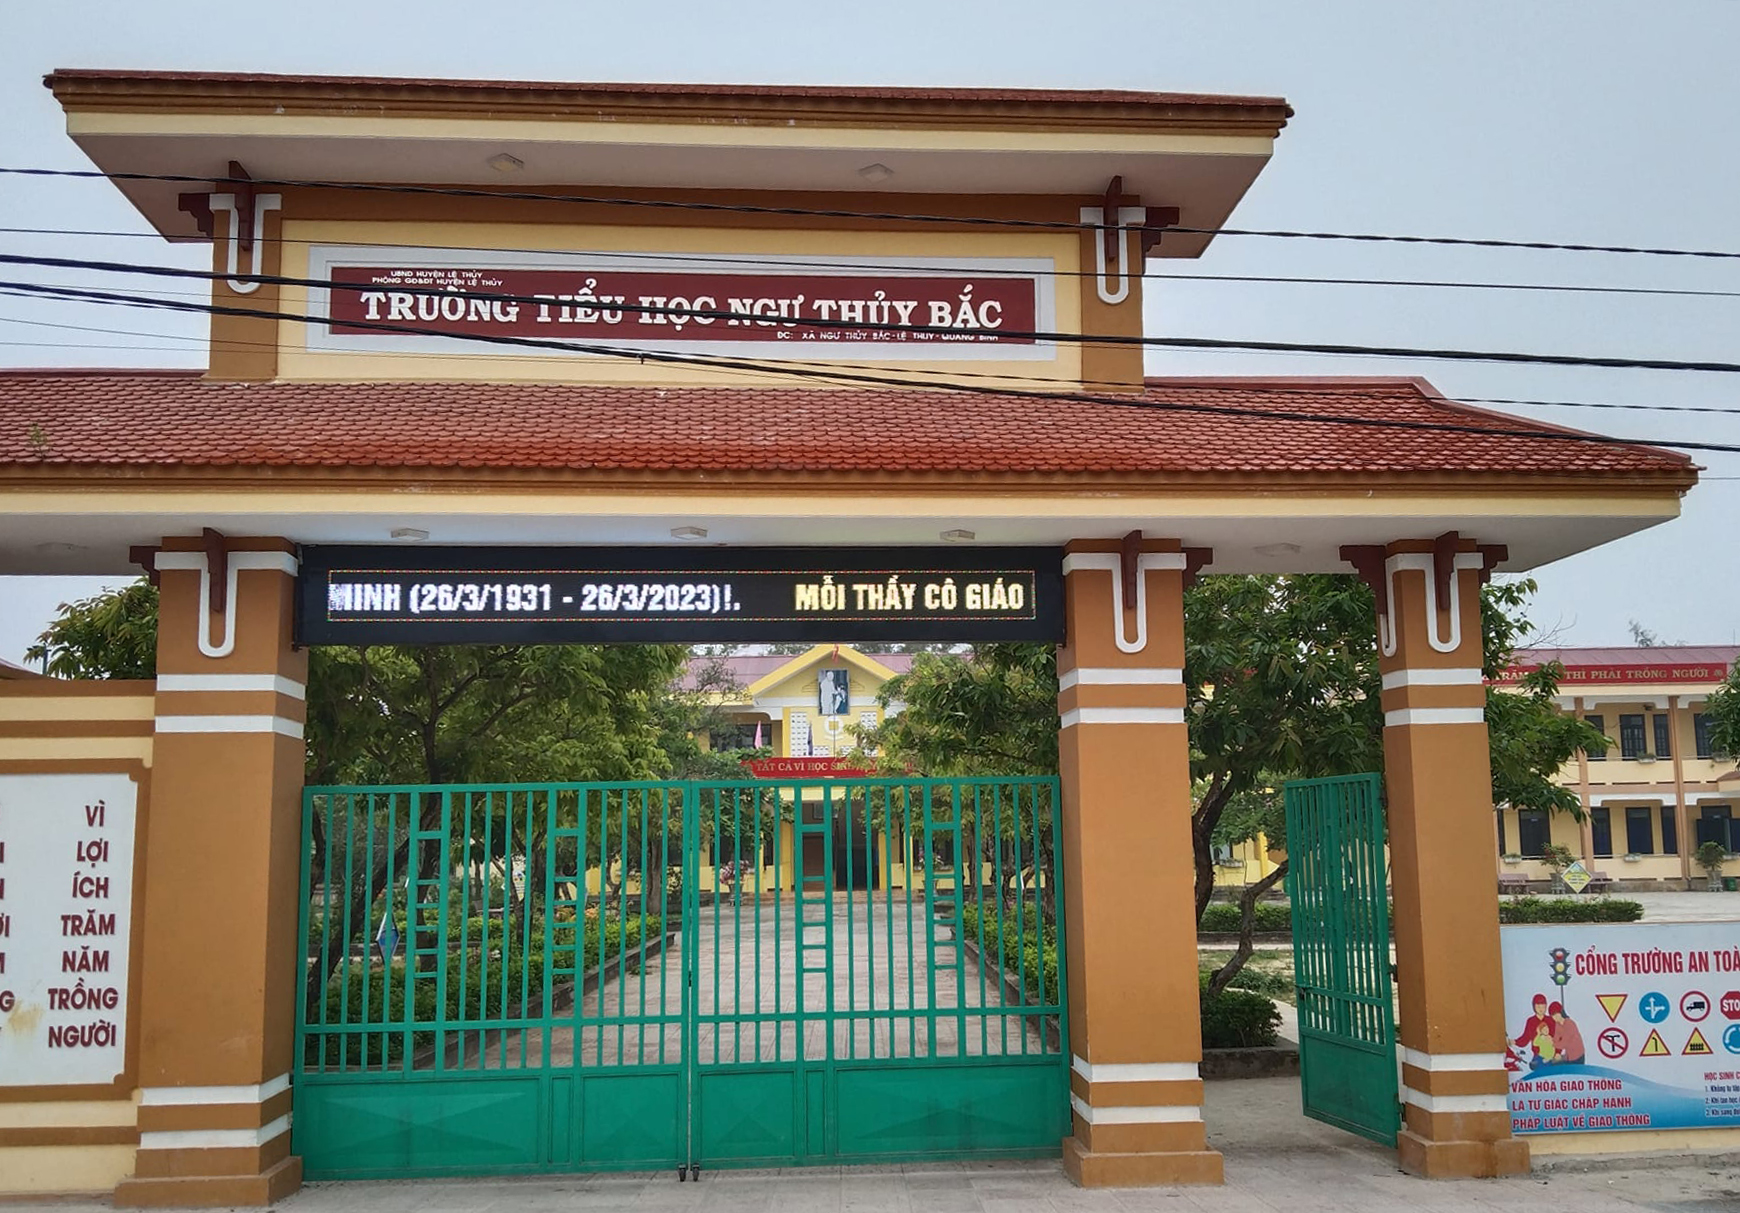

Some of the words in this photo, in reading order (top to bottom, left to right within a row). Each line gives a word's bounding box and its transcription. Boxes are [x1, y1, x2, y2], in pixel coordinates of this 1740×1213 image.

[390, 270, 414, 278] UBND
[534, 278, 625, 324] TIỂU
[638, 295, 717, 331] HỌC
[727, 294, 805, 327] NGƯ
[812, 290, 919, 327] THỦY
[928, 284, 1003, 329] BẮC
[409, 583, 552, 614] (26/3/1931
[562, 596, 573, 604] -
[795, 575, 846, 611] MỖI
[924, 577, 958, 611] CÔ
[965, 577, 1025, 611] GIÁO
[1672, 665, 1709, 678] NGƯỜI
[807, 762, 828, 774] HỌC
[85, 800, 106, 827] VÌ
[76, 838, 109, 868] LỢI
[72, 871, 110, 899] ÍCH
[61, 908, 116, 937] TRĂM
[61, 945, 110, 973] NĂM
[1575, 944, 1618, 976] CỔNG
[1622, 947, 1684, 975] TRƯỜNG
[1688, 951, 1711, 973] AN
[48, 977, 119, 1011] TRỒNG
[48, 1019, 117, 1049] NGƯỜI
[1560, 1080, 1585, 1092] GIAO
[1588, 1115, 1613, 1127] GIAO
